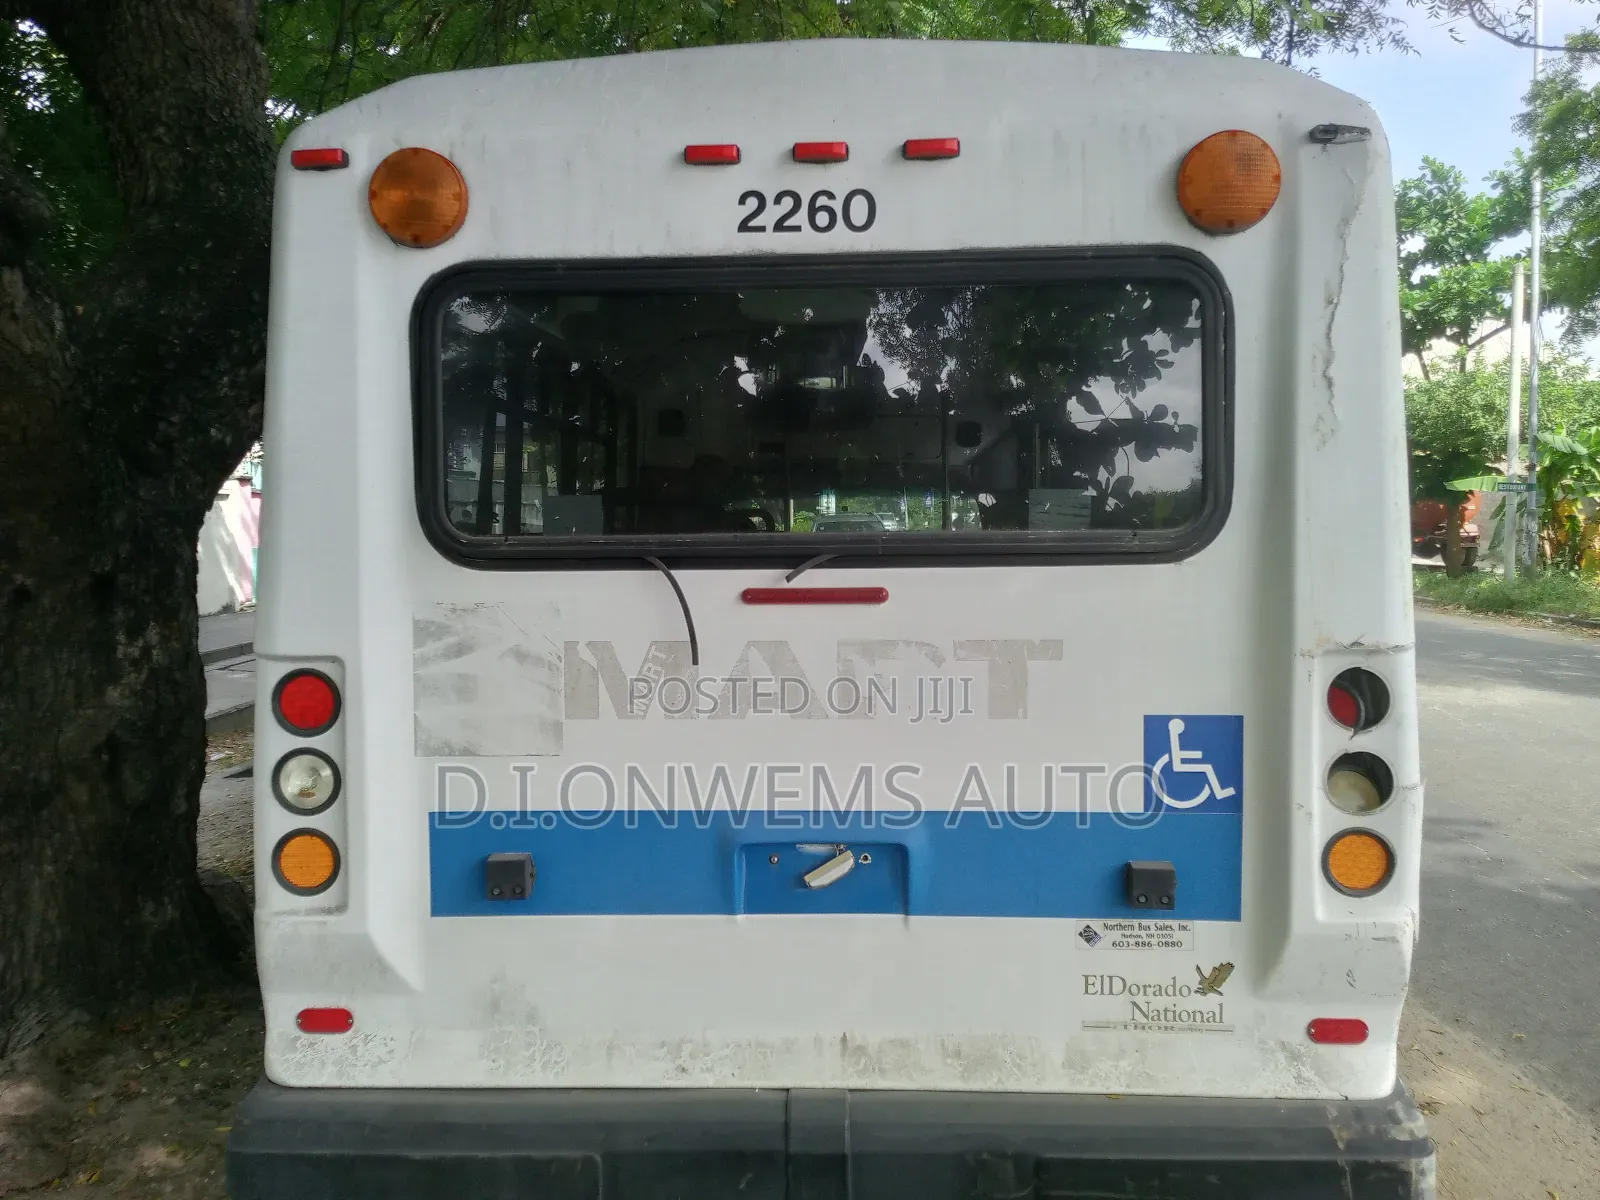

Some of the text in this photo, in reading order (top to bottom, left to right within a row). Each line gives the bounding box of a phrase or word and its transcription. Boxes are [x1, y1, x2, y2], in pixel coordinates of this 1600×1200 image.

[737, 188, 877, 233] 2260
[1103, 922, 1191, 933] Northern Bus Sales, Inc.
[1112, 940, 1183, 949] 603-886-0880
[1082, 974, 1192, 998] ElDorado
[1130, 1000, 1225, 1024] National
